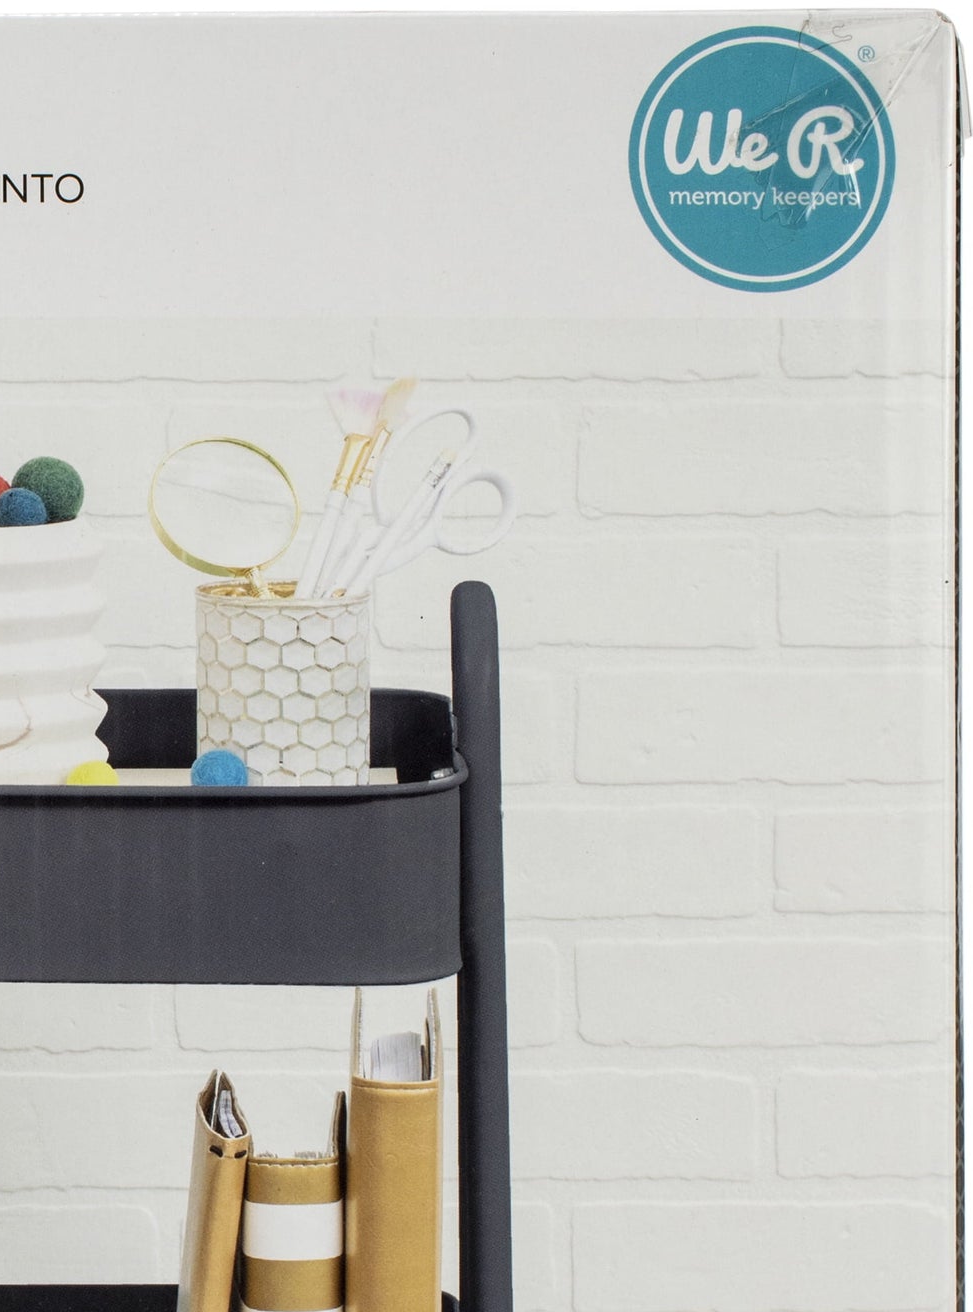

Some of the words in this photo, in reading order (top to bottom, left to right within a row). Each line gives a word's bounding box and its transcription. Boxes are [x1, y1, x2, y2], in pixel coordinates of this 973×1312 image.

[663, 108, 779, 176] We
[786, 105, 865, 180] R
[668, 187, 766, 210] memory
[771, 184, 861, 210] keepers
